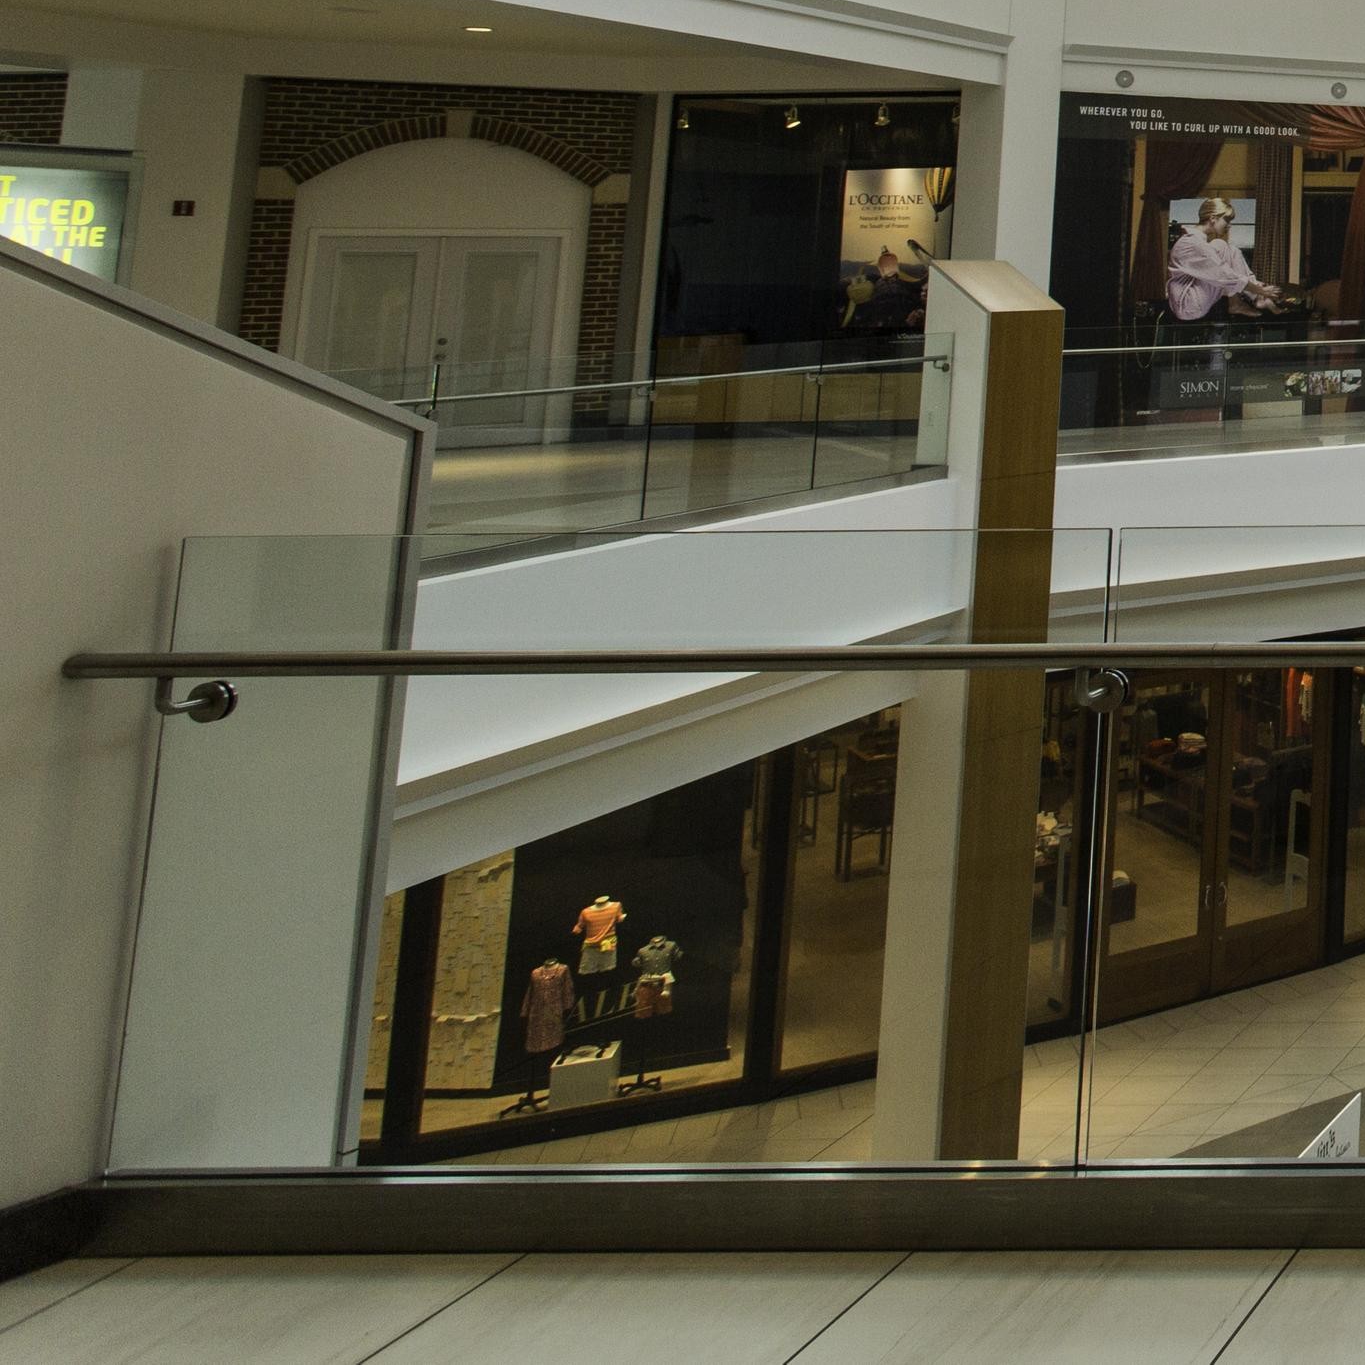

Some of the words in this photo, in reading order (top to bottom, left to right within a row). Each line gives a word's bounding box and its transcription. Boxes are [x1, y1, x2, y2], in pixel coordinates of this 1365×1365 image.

[1079, 106, 1128, 117] WHEREVER
[1130, 107, 1148, 118] YOU
[1150, 109, 1165, 120] GO,
[1129, 120, 1147, 130] YOU
[1150, 121, 1169, 131] LIKE
[1171, 122, 1182, 132] TO
[1184, 123, 1206, 133] CURL
[1208, 124, 1220, 133] UP
[1222, 125, 1243, 134] WITH
[1245, 125, 1251, 134] A
[1253, 126, 1276, 135] GOOD
[1277, 127, 1300, 137] LOOK.
[849, 193, 925, 206] L'OCCITANE
[52, 226, 107, 247] THE
[1179, 379, 1219, 394] SIMON
[566, 980, 640, 1025] ALE
